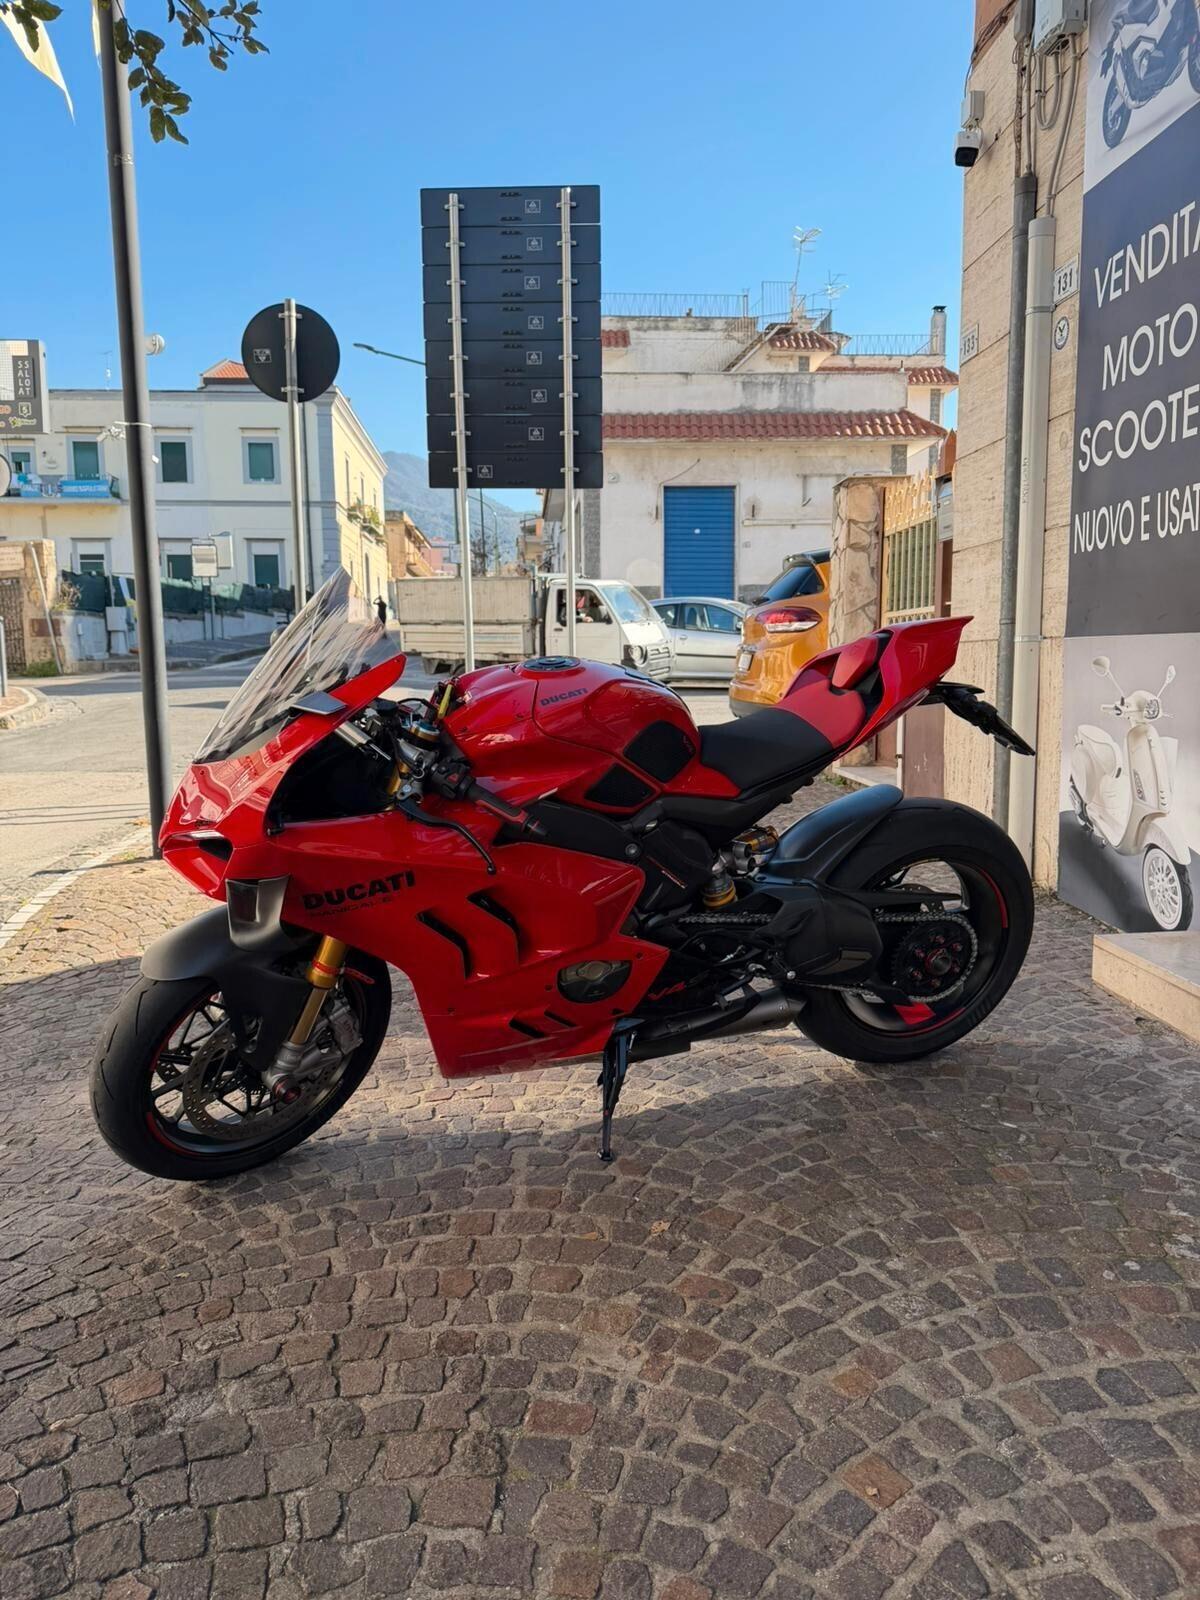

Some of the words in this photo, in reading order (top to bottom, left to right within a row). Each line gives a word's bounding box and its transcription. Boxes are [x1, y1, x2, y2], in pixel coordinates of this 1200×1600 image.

[1057, 268, 1073, 295] 131
[963, 334, 975, 356] 133
[1102, 303, 1198, 391] MOTO
[1074, 499, 1135, 554] NUOVO
[1140, 495, 1151, 541] E
[540, 687, 589, 707] DUCATI
[302, 869, 415, 910] DUCATI
